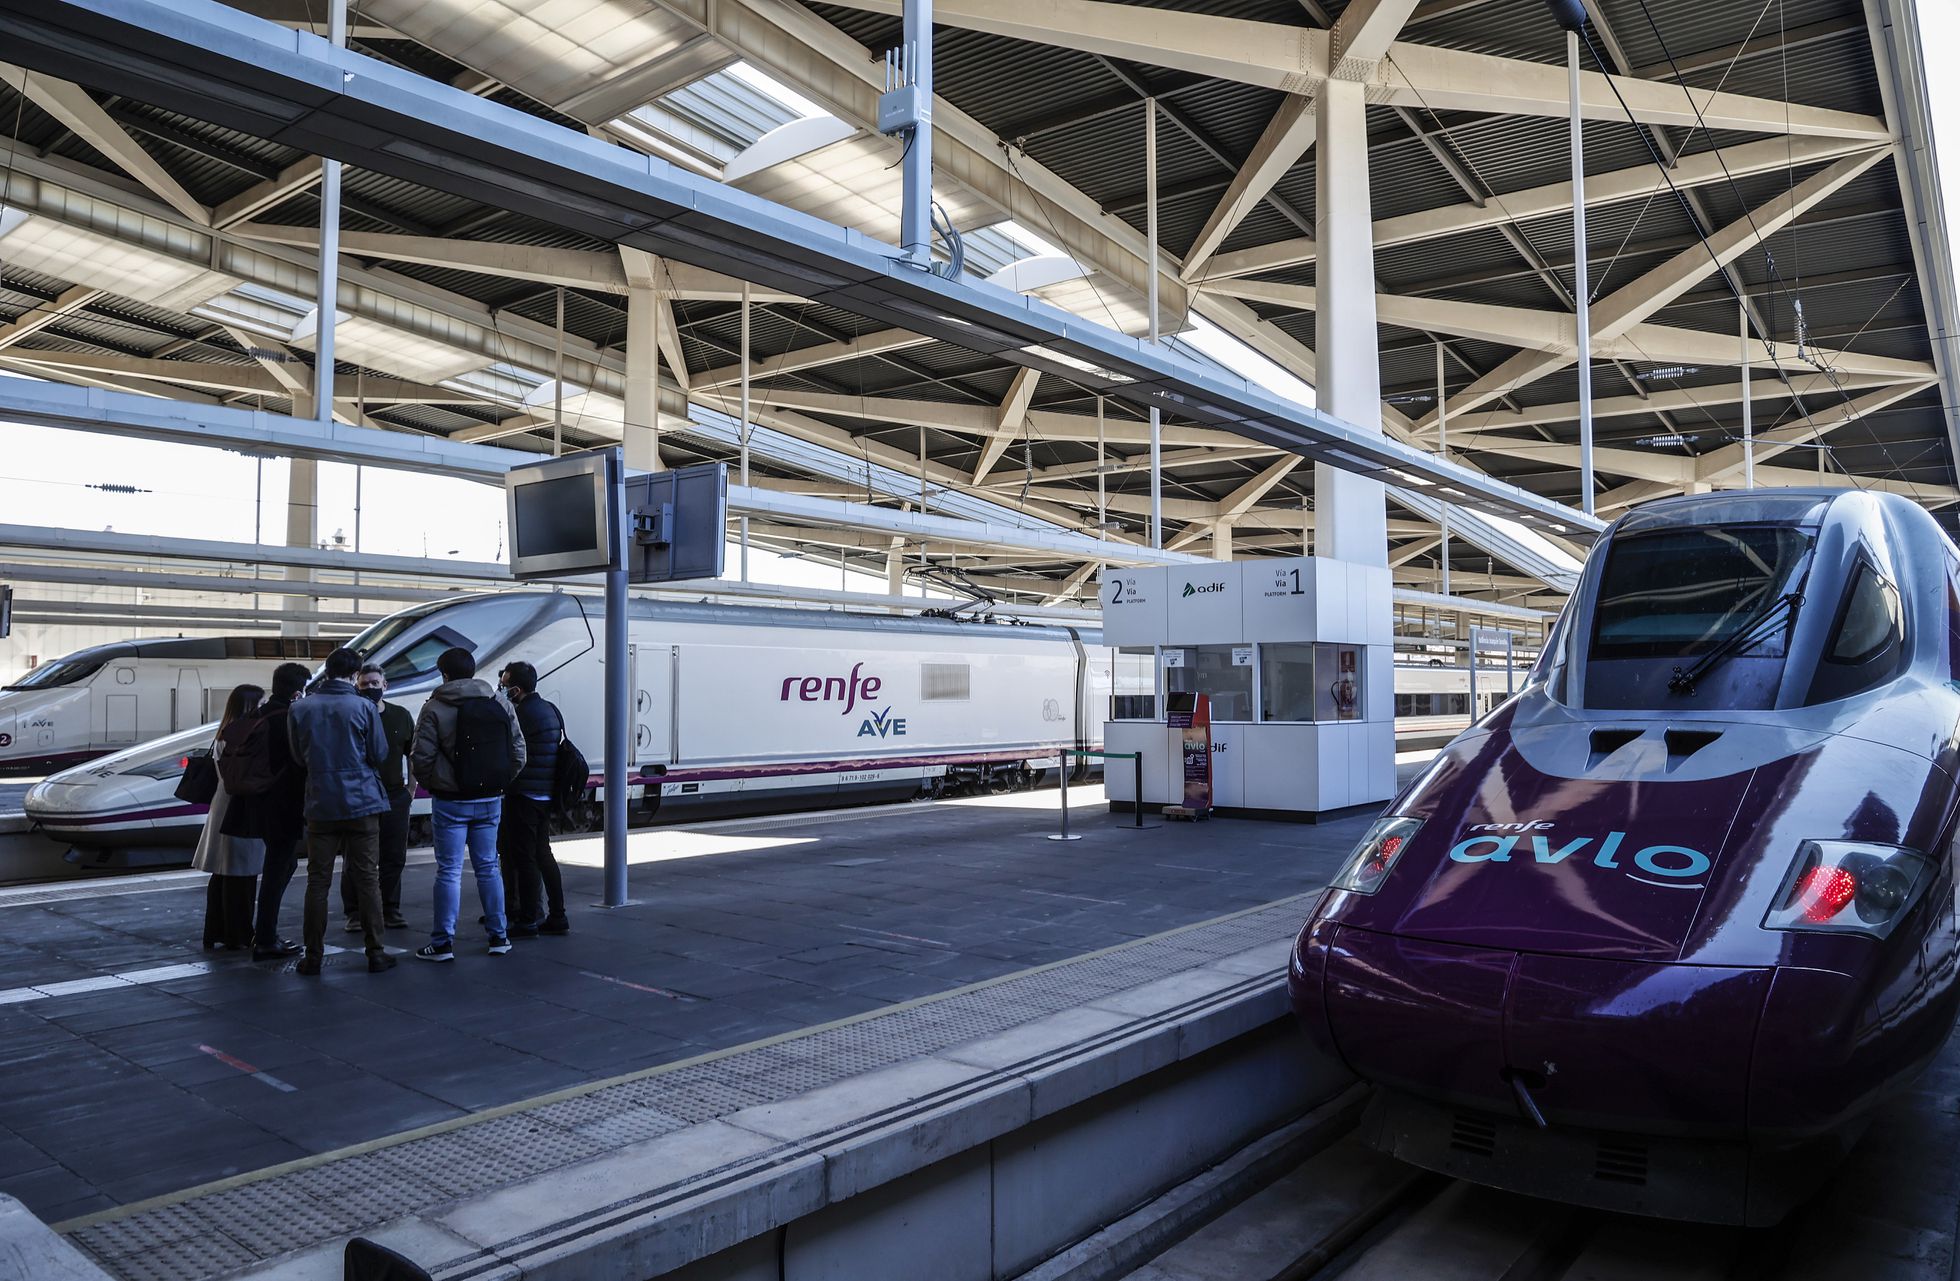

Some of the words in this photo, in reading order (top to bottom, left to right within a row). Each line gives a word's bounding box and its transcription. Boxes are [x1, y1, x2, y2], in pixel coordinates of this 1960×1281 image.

[1111, 579, 1123, 604] 2
[1197, 582, 1226, 593] adif
[1290, 568, 1305, 595] 1
[780, 661, 882, 716] renfe
[31, 718, 54, 728] AVE
[857, 705, 906, 739] AVE
[1184, 741, 1206, 750] avlo
[1210, 742, 1227, 752] dif
[1469, 818, 1556, 833] renfe
[1449, 831, 1711, 877] avlo
